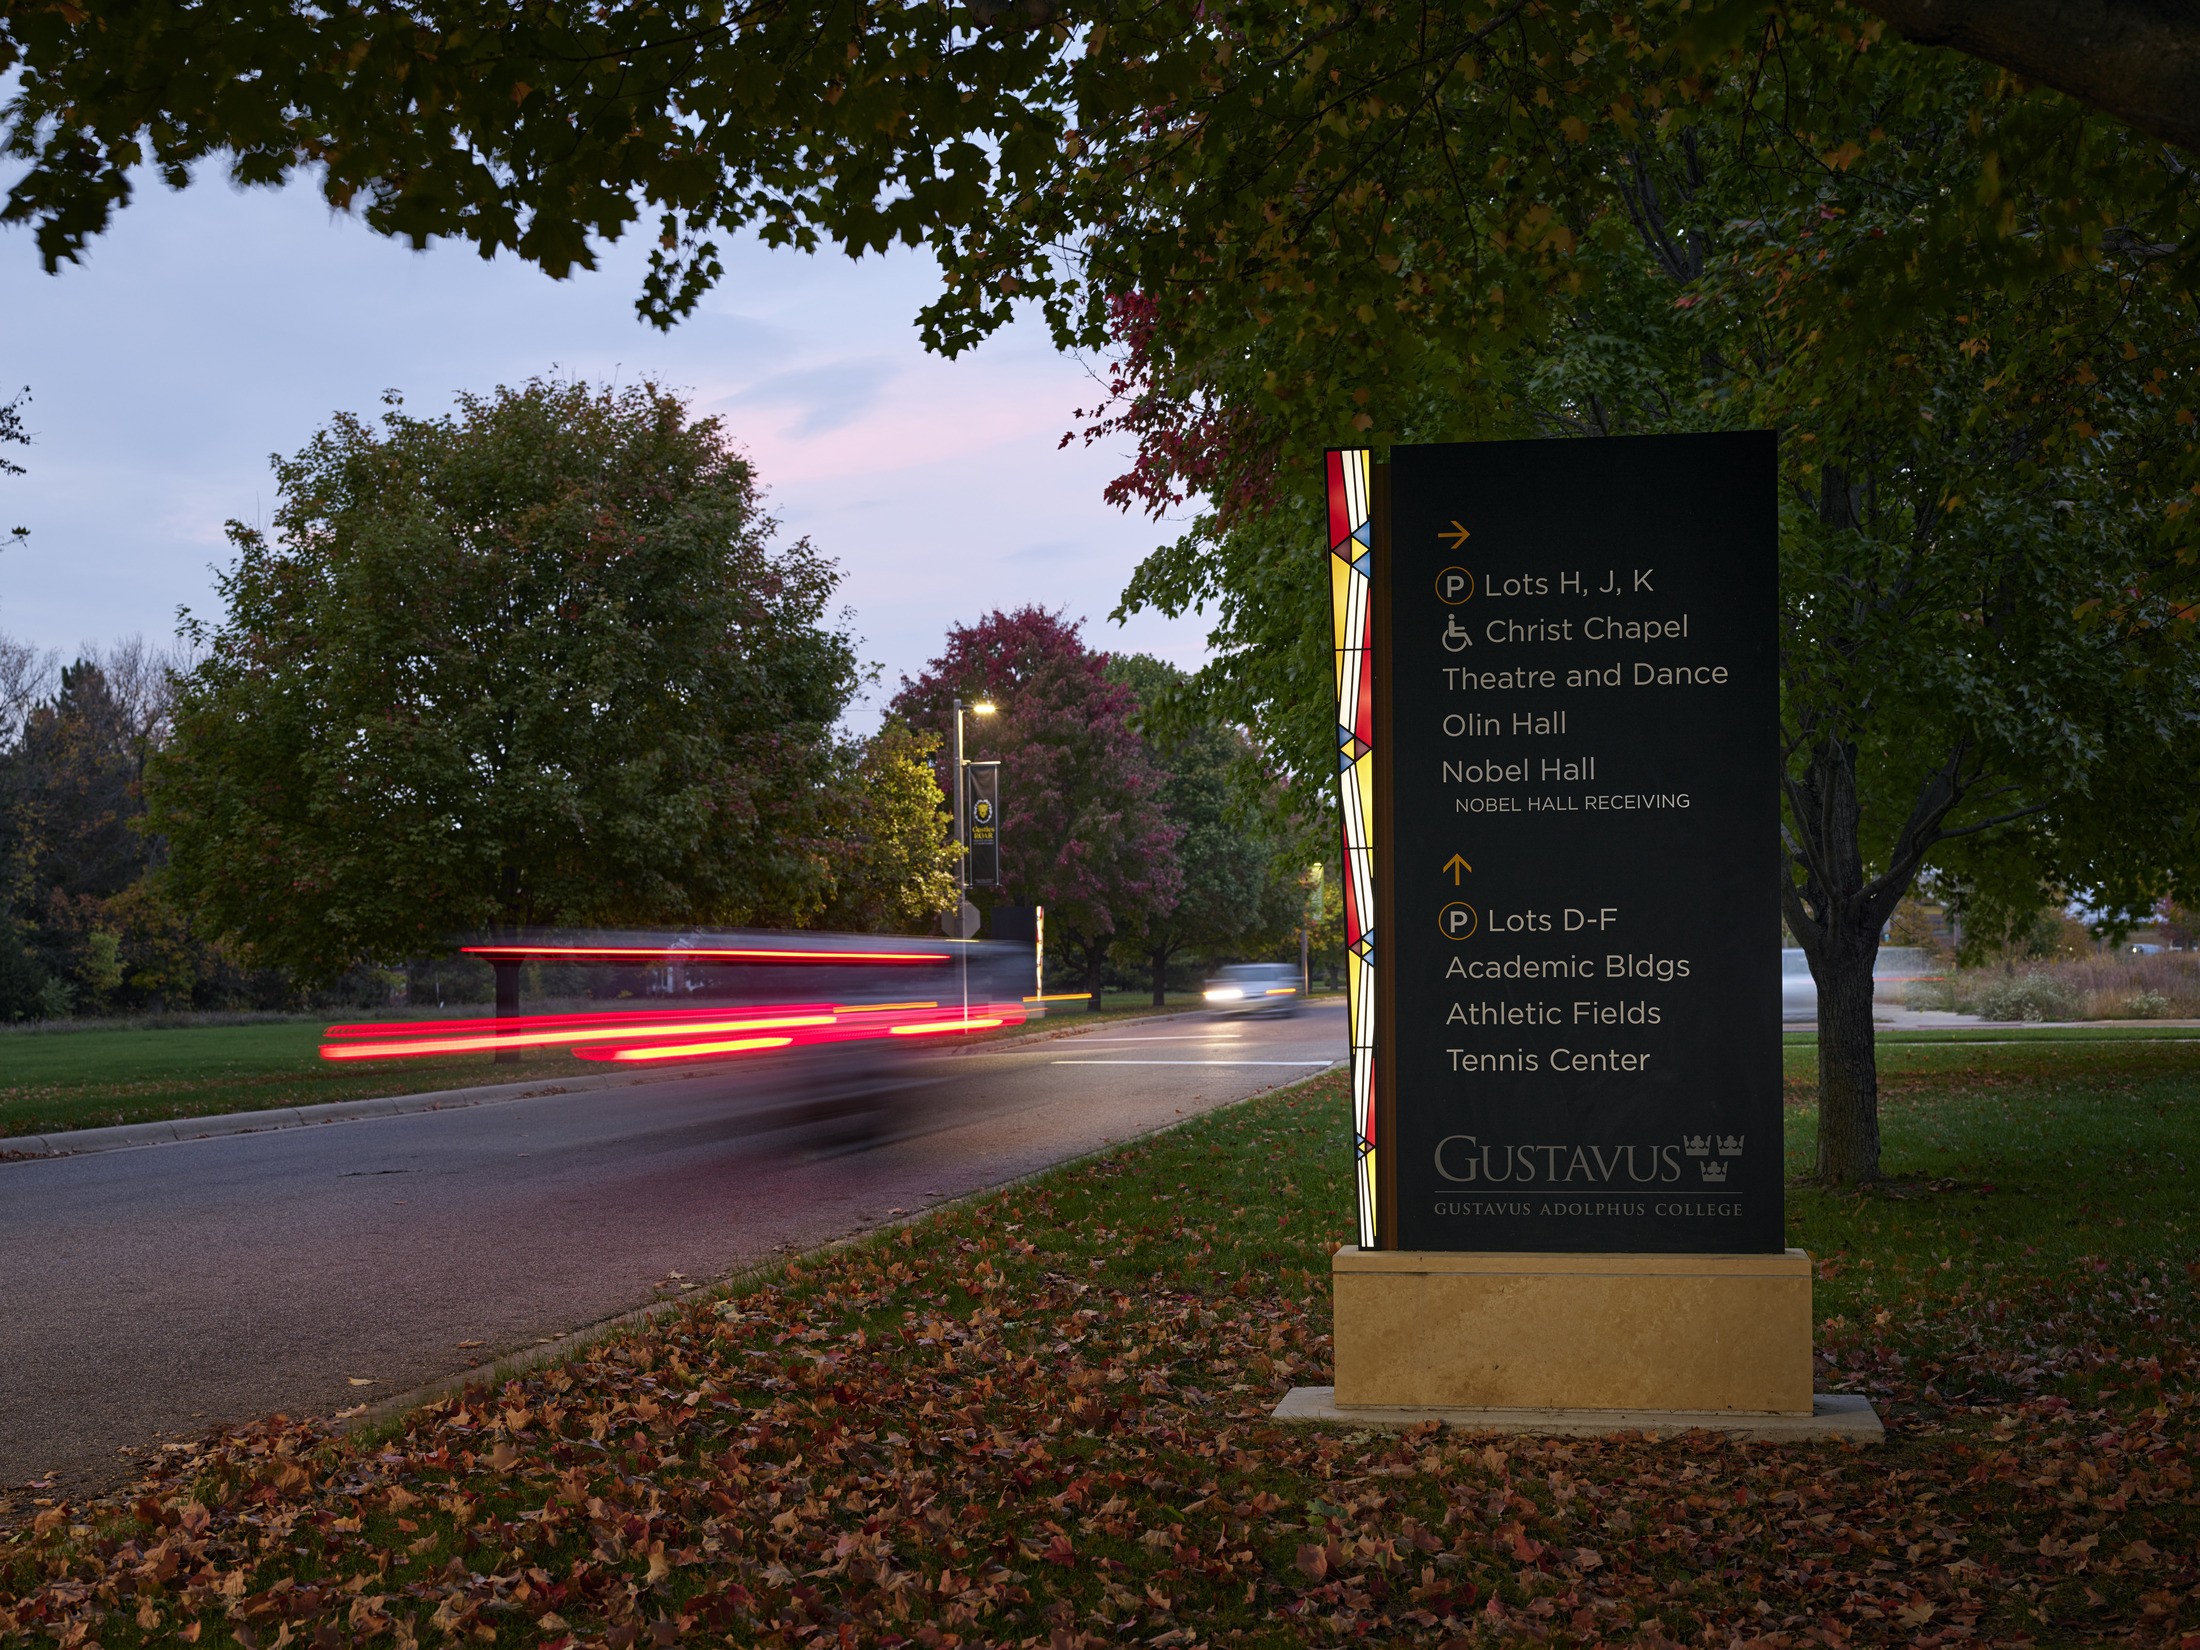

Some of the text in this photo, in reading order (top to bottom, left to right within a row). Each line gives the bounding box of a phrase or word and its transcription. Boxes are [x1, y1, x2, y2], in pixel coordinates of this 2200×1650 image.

[1446, 568, 1654, 598] P Lots H, J, K
[1486, 613, 1688, 644] Christ Chapel
[1442, 662, 1729, 691] Theatre and Dance
[1442, 710, 1566, 737] Olin Hall
[1442, 756, 1595, 783] Nobel Hall
[1456, 793, 1690, 813] NOBEL HALL RECEIVING
[1450, 908, 1618, 933] P Lots D-F
[1445, 953, 1690, 982] Academic Bldgs
[1445, 1000, 1661, 1025] Athletic Fields
[1446, 1048, 1651, 1072] Tennis Center
[1434, 1134, 1681, 1183] GUSTAVUS
[1434, 1202, 1743, 1217] GUSTAVUS ADOLPHUS COLLEGE
